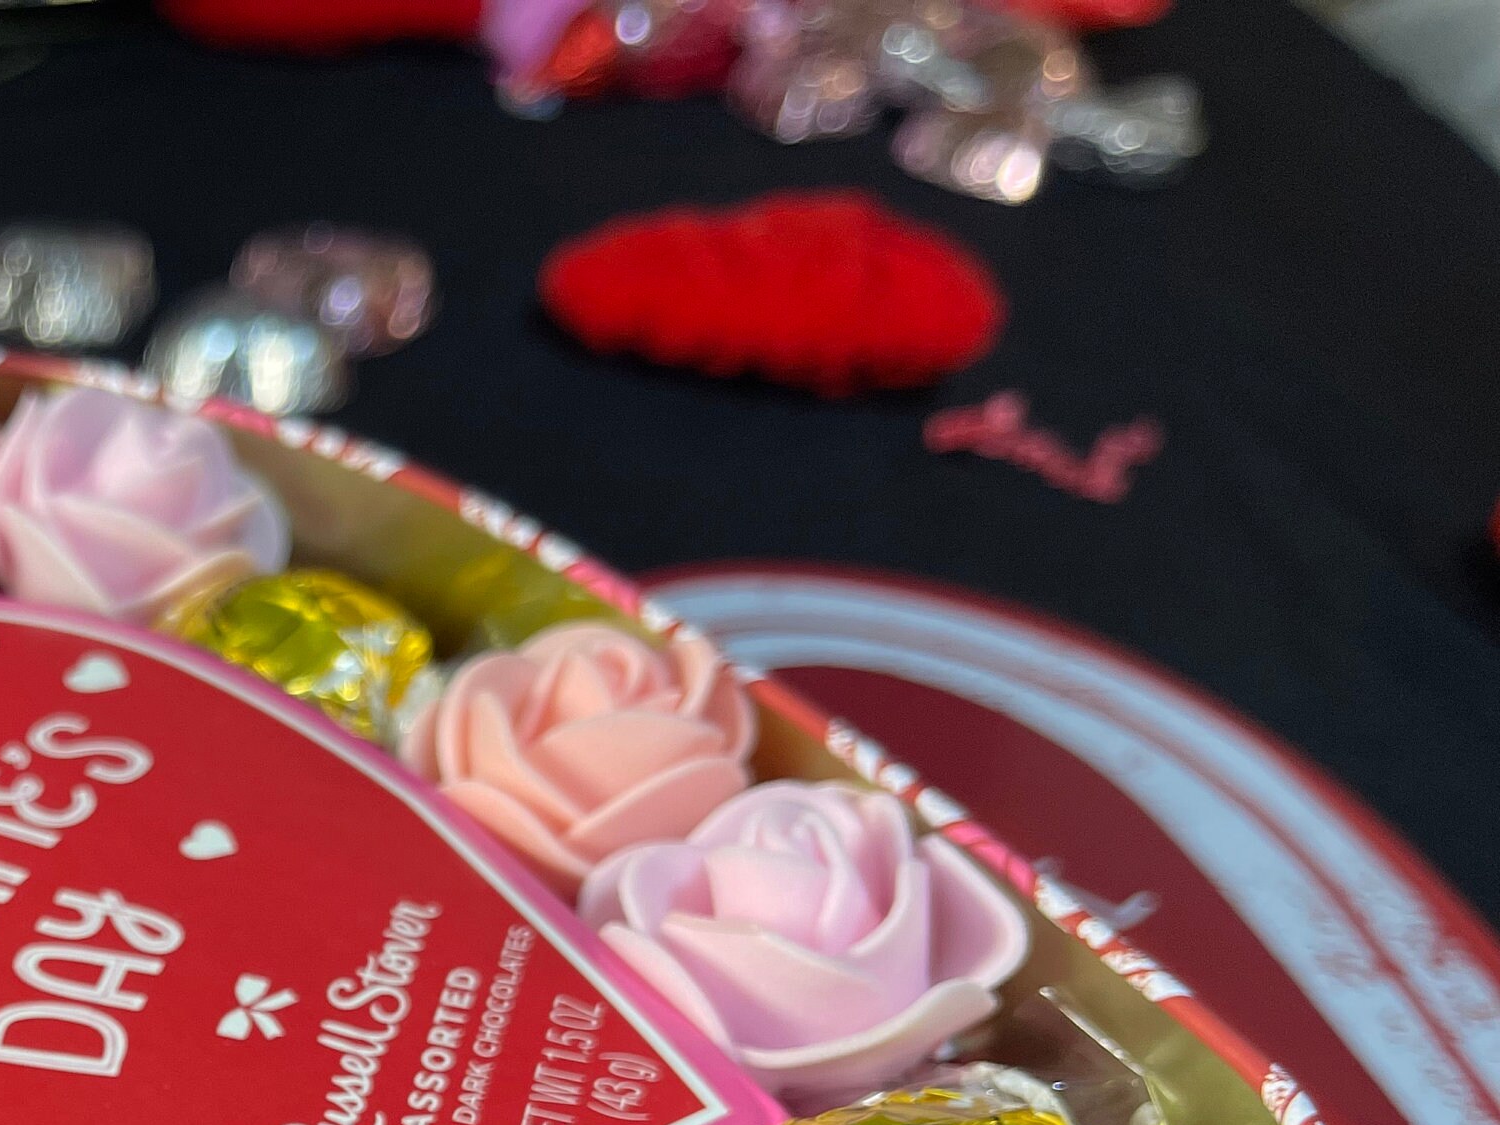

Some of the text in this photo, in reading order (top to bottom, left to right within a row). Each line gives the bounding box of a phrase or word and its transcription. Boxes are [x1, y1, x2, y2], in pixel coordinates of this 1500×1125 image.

[326, 899, 443, 1024] Stover
[472, 923, 536, 1058] CHOCOLATES
[550, 994, 607, 1031] OZ
[452, 1060, 496, 1125] DARK
[528, 1062, 587, 1106] WT
